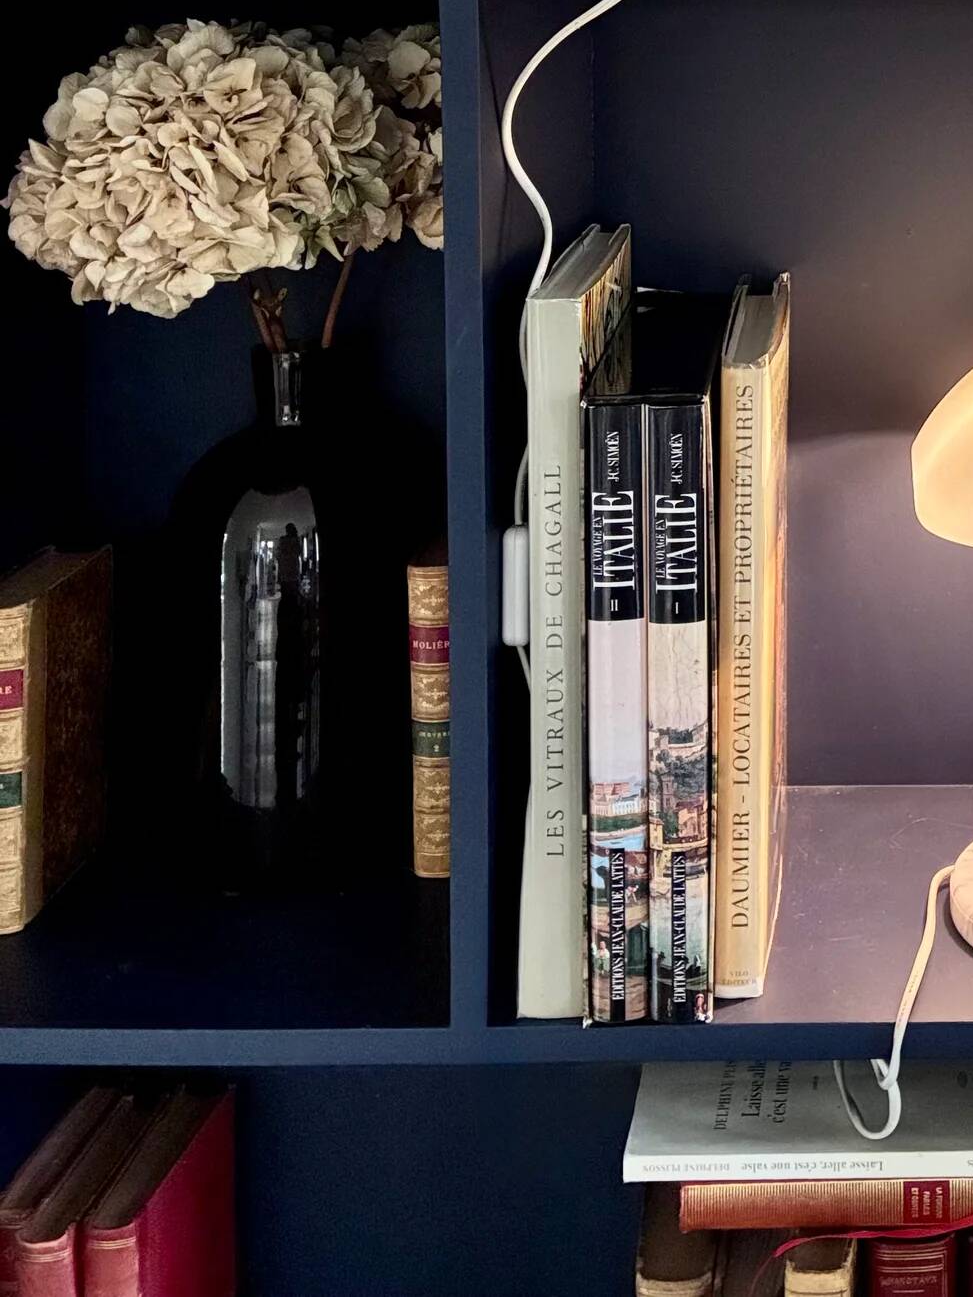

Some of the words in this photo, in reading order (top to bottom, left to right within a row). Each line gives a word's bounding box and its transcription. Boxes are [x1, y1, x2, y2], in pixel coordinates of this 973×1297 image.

[731, 384, 755, 590] PROPRIÉTAIRES
[544, 464, 563, 597] CHAGALL
[593, 517, 602, 529] EN
[655, 519, 665, 531] EN
[591, 490, 635, 591] ITALIE
[593, 531, 602, 562] VOYAGE
[654, 492, 698, 594] ITALIE
[655, 533, 665, 564] VOYAGE
[593, 564, 602, 576] LE
[655, 567, 665, 578] LE
[734, 596, 752, 624] ET
[545, 614, 563, 653] DE
[732, 631, 752, 787] LOCATAIRES
[546, 668, 564, 791] VITRAUX
[546, 809, 564, 857] LES
[731, 811, 751, 928] DAUMIER
[611, 889, 625, 956] JEAN-CLAUDE
[672, 892, 686, 958] JEAN-CLAUDE
[741, 1075, 764, 1118] Laisse
[767, 1101, 785, 1124] c'est
[778, 1079, 791, 1100] une
[642, 1163, 682, 1173] PLISSON
[683, 1162, 731, 1172] DELPHINE
[741, 1161, 768, 1172] valse
[770, 1163, 791, 1171] une
[793, 1161, 817, 1172] c'est
[820, 1162, 848, 1173] aller,
[850, 1161, 884, 1172] Laisse
